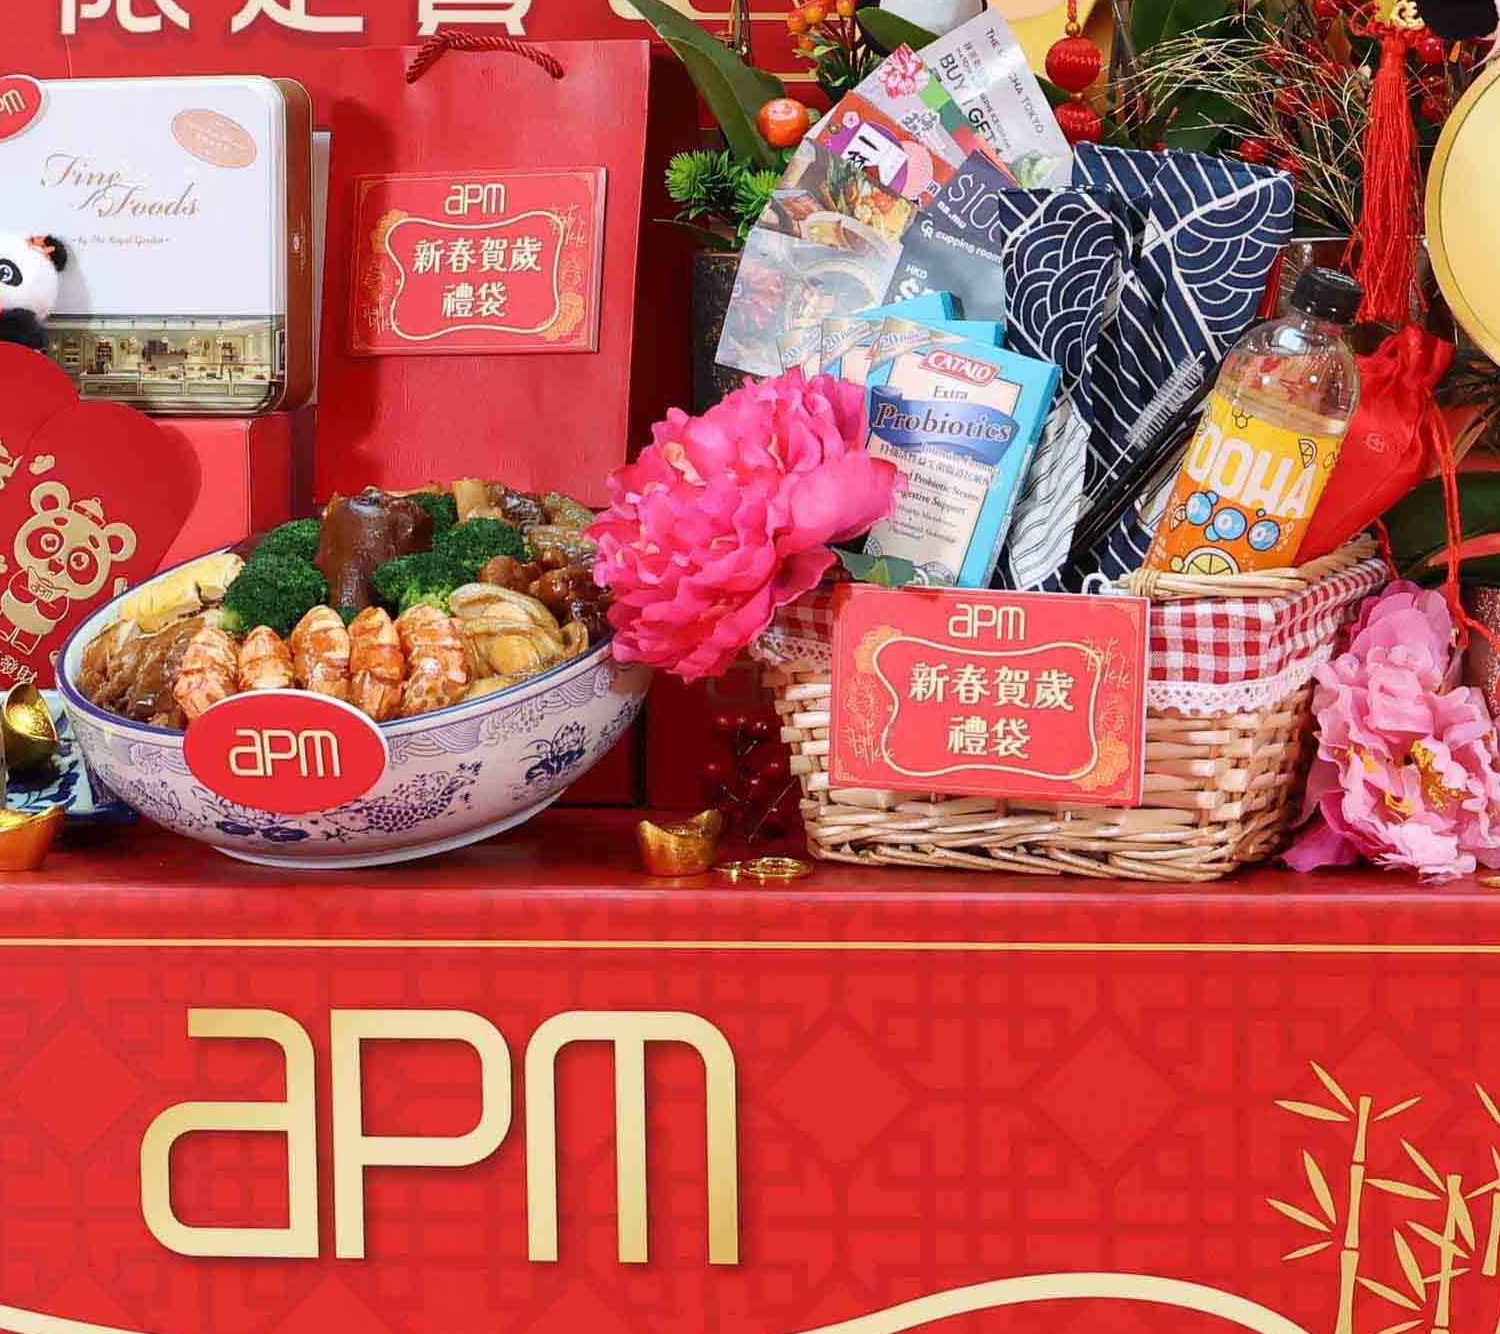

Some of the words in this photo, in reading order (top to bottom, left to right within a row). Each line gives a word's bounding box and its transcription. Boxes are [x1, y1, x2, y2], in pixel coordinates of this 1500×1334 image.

[940, 53, 968, 90] BUY
[40, 152, 127, 189] Fine
[75, 180, 200, 219] Foods
[412, 234, 542, 274] 新春賀歲
[441, 281, 507, 318] 禮袋
[928, 350, 993, 380] CATALO
[932, 385, 969, 401] Extra
[873, 402, 1013, 441] Probiotics
[1187, 423, 1316, 519] OOHA
[908, 661, 1076, 711] 新春賀歲
[946, 716, 1032, 760] 禮袋
